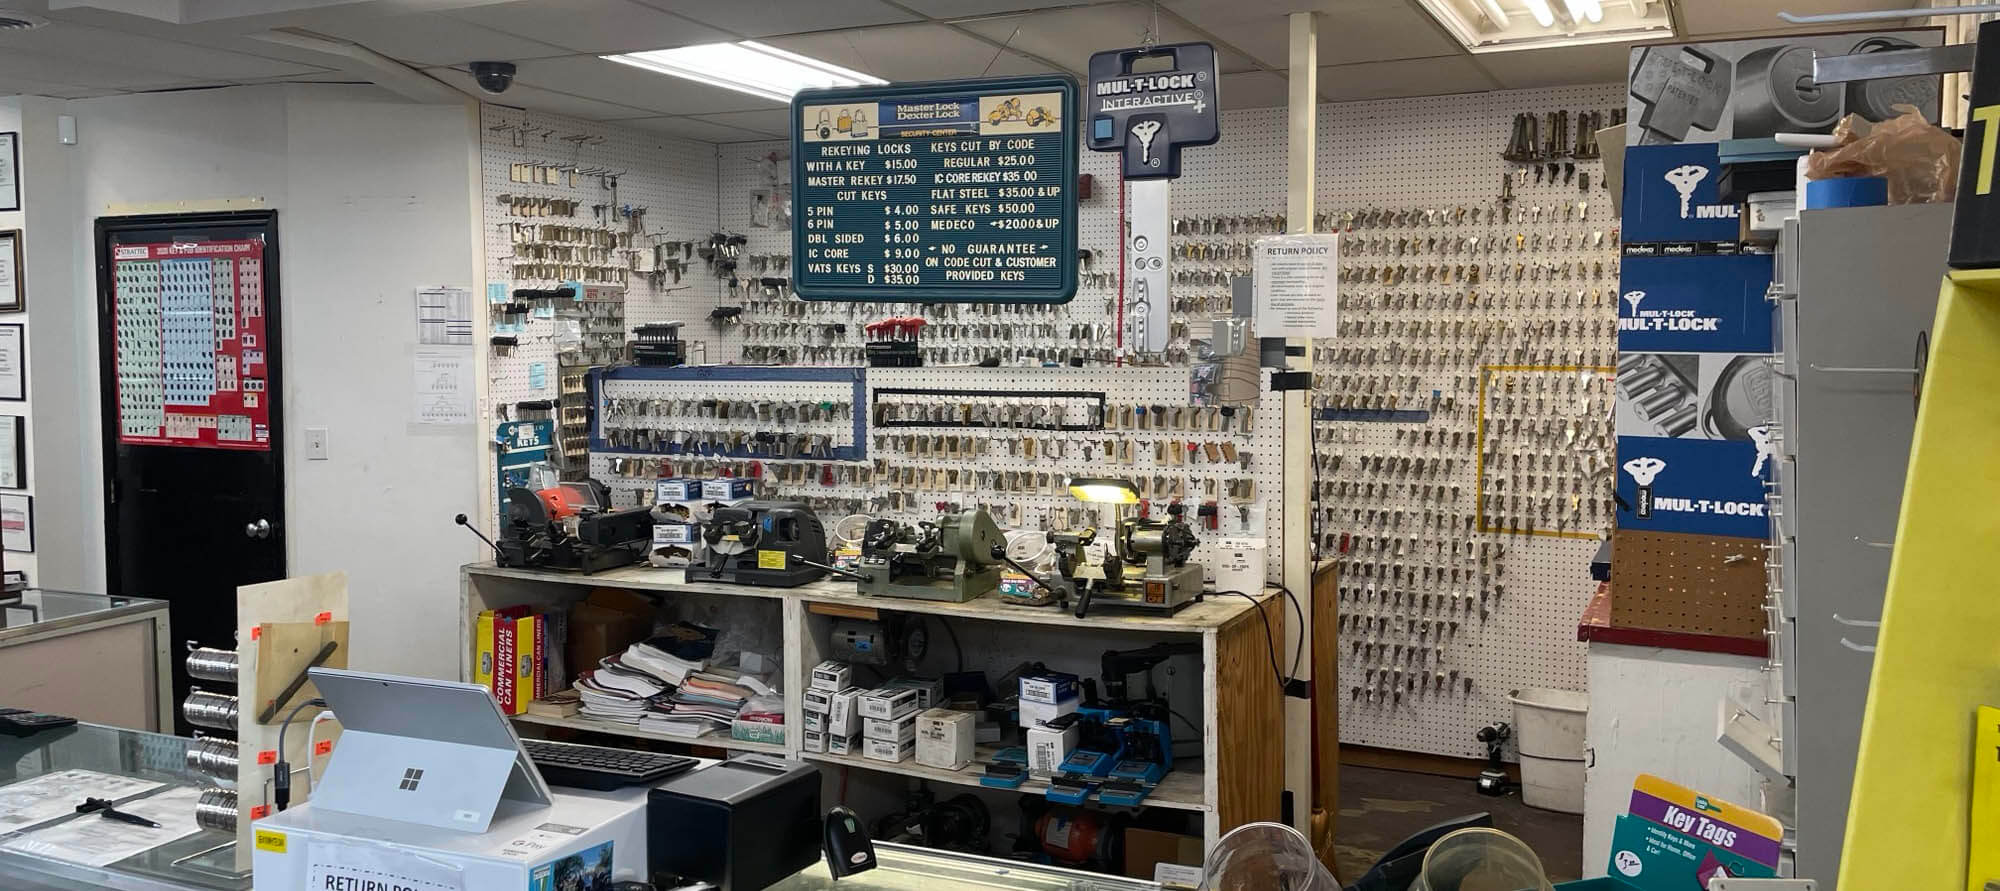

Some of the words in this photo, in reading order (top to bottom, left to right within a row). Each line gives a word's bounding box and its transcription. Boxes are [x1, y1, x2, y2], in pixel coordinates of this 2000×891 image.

[1097, 74, 1194, 95] MUL-T-LOCK
[897, 104, 934, 112] Master
[936, 102, 960, 111] Lock
[1102, 92, 1192, 110] INTERACTIVE
[897, 112, 934, 120] Dexter
[936, 110, 960, 118] Lock
[822, 145, 870, 156] REKEYING
[878, 144, 911, 154] LOCKS
[930, 142, 956, 152] KEYS
[960, 142, 982, 151] CUT
[989, 140, 1001, 150] BY
[1008, 139, 1035, 150] CODE
[806, 161, 832, 171] WITH
[836, 161, 842, 171] A
[846, 160, 865, 170] KEY
[885, 159, 917, 170] $15.00
[944, 156, 990, 168] REGULAR
[998, 155, 1035, 166] $25.00
[808, 176, 845, 186] MASTER
[850, 175, 883, 185] REKEY
[886, 174, 916, 185] $17.50
[935, 174, 944, 184] IC
[946, 173, 970, 183] CORE
[972, 172, 1001, 182] REKEY
[837, 191, 856, 200] CUT
[861, 191, 887, 200] KEYS
[931, 189, 955, 199] FLAT
[960, 188, 990, 198] STEEL
[998, 187, 1034, 198] $35.00
[1038, 187, 1045, 196] &
[1048, 186, 1060, 196] UP
[808, 207, 813, 216] 5
[817, 206, 834, 216] PIN
[930, 204, 957, 215] SAFE
[965, 204, 991, 214] KEYS
[998, 203, 1035, 213] $50.00
[1696, 205, 1740, 218] MUL-
[808, 220, 814, 229] 6
[816, 220, 834, 229] PIN
[931, 220, 975, 230] MEDECO
[808, 234, 827, 243] DBL
[835, 234, 864, 243] SIDED
[808, 249, 818, 258] IC
[824, 248, 848, 258] CORE
[942, 244, 956, 254] NO
[967, 244, 1036, 254] GUARANTEE
[925, 257, 938, 267] ON
[944, 257, 969, 267] CODE
[972, 257, 992, 267] CUT
[995, 257, 1002, 267] &
[1006, 257, 1056, 267] CUSTOMER
[808, 264, 831, 273] VATS
[836, 264, 861, 273] KEYS
[867, 264, 874, 273] S
[884, 264, 919, 274] $30.00
[868, 275, 875, 284] D
[884, 275, 920, 284] $35.00
[946, 271, 994, 280] PROVIDED
[1000, 271, 1024, 280] KEYS
[1654, 497, 1764, 516] MUL-T-LOCK
[496, 627, 506, 704] COMMERCIAL
[504, 681, 512, 705] CAN
[1663, 805, 1696, 832] Key
[1696, 817, 1736, 848] Tags
[326, 875, 388, 891] RETURN
